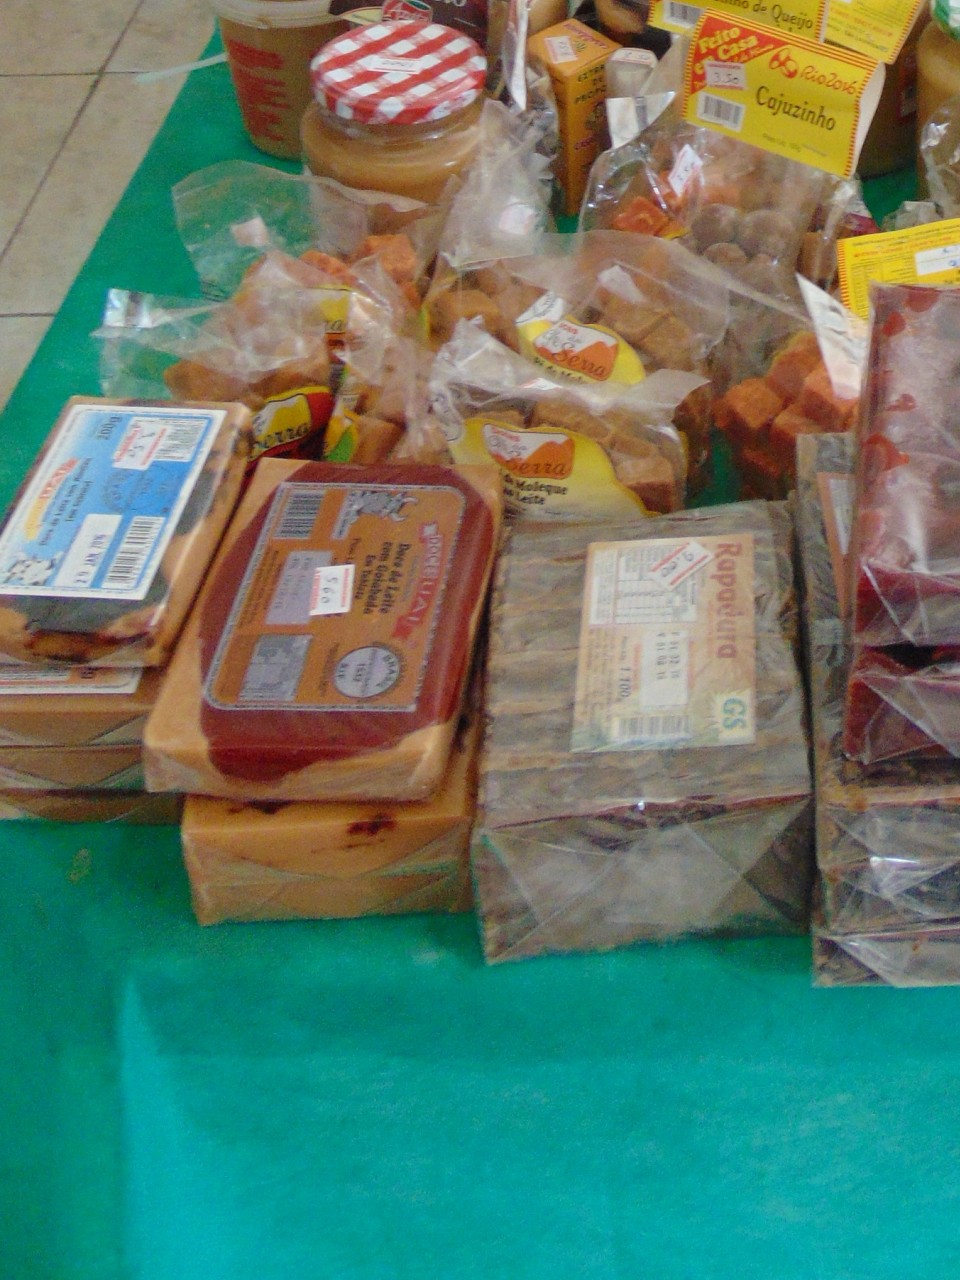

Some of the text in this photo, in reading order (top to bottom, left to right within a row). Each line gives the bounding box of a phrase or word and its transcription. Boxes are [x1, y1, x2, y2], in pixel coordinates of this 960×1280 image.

[752, 0, 767, 13] de
[771, 4, 813, 30] Queijo
[699, 27, 741, 54] Feito
[717, 35, 758, 61] Casa
[755, 85, 837, 131] Cajuzinho
[710, 542, 744, 659] Rapadura
[722, 697, 747, 730] GS
